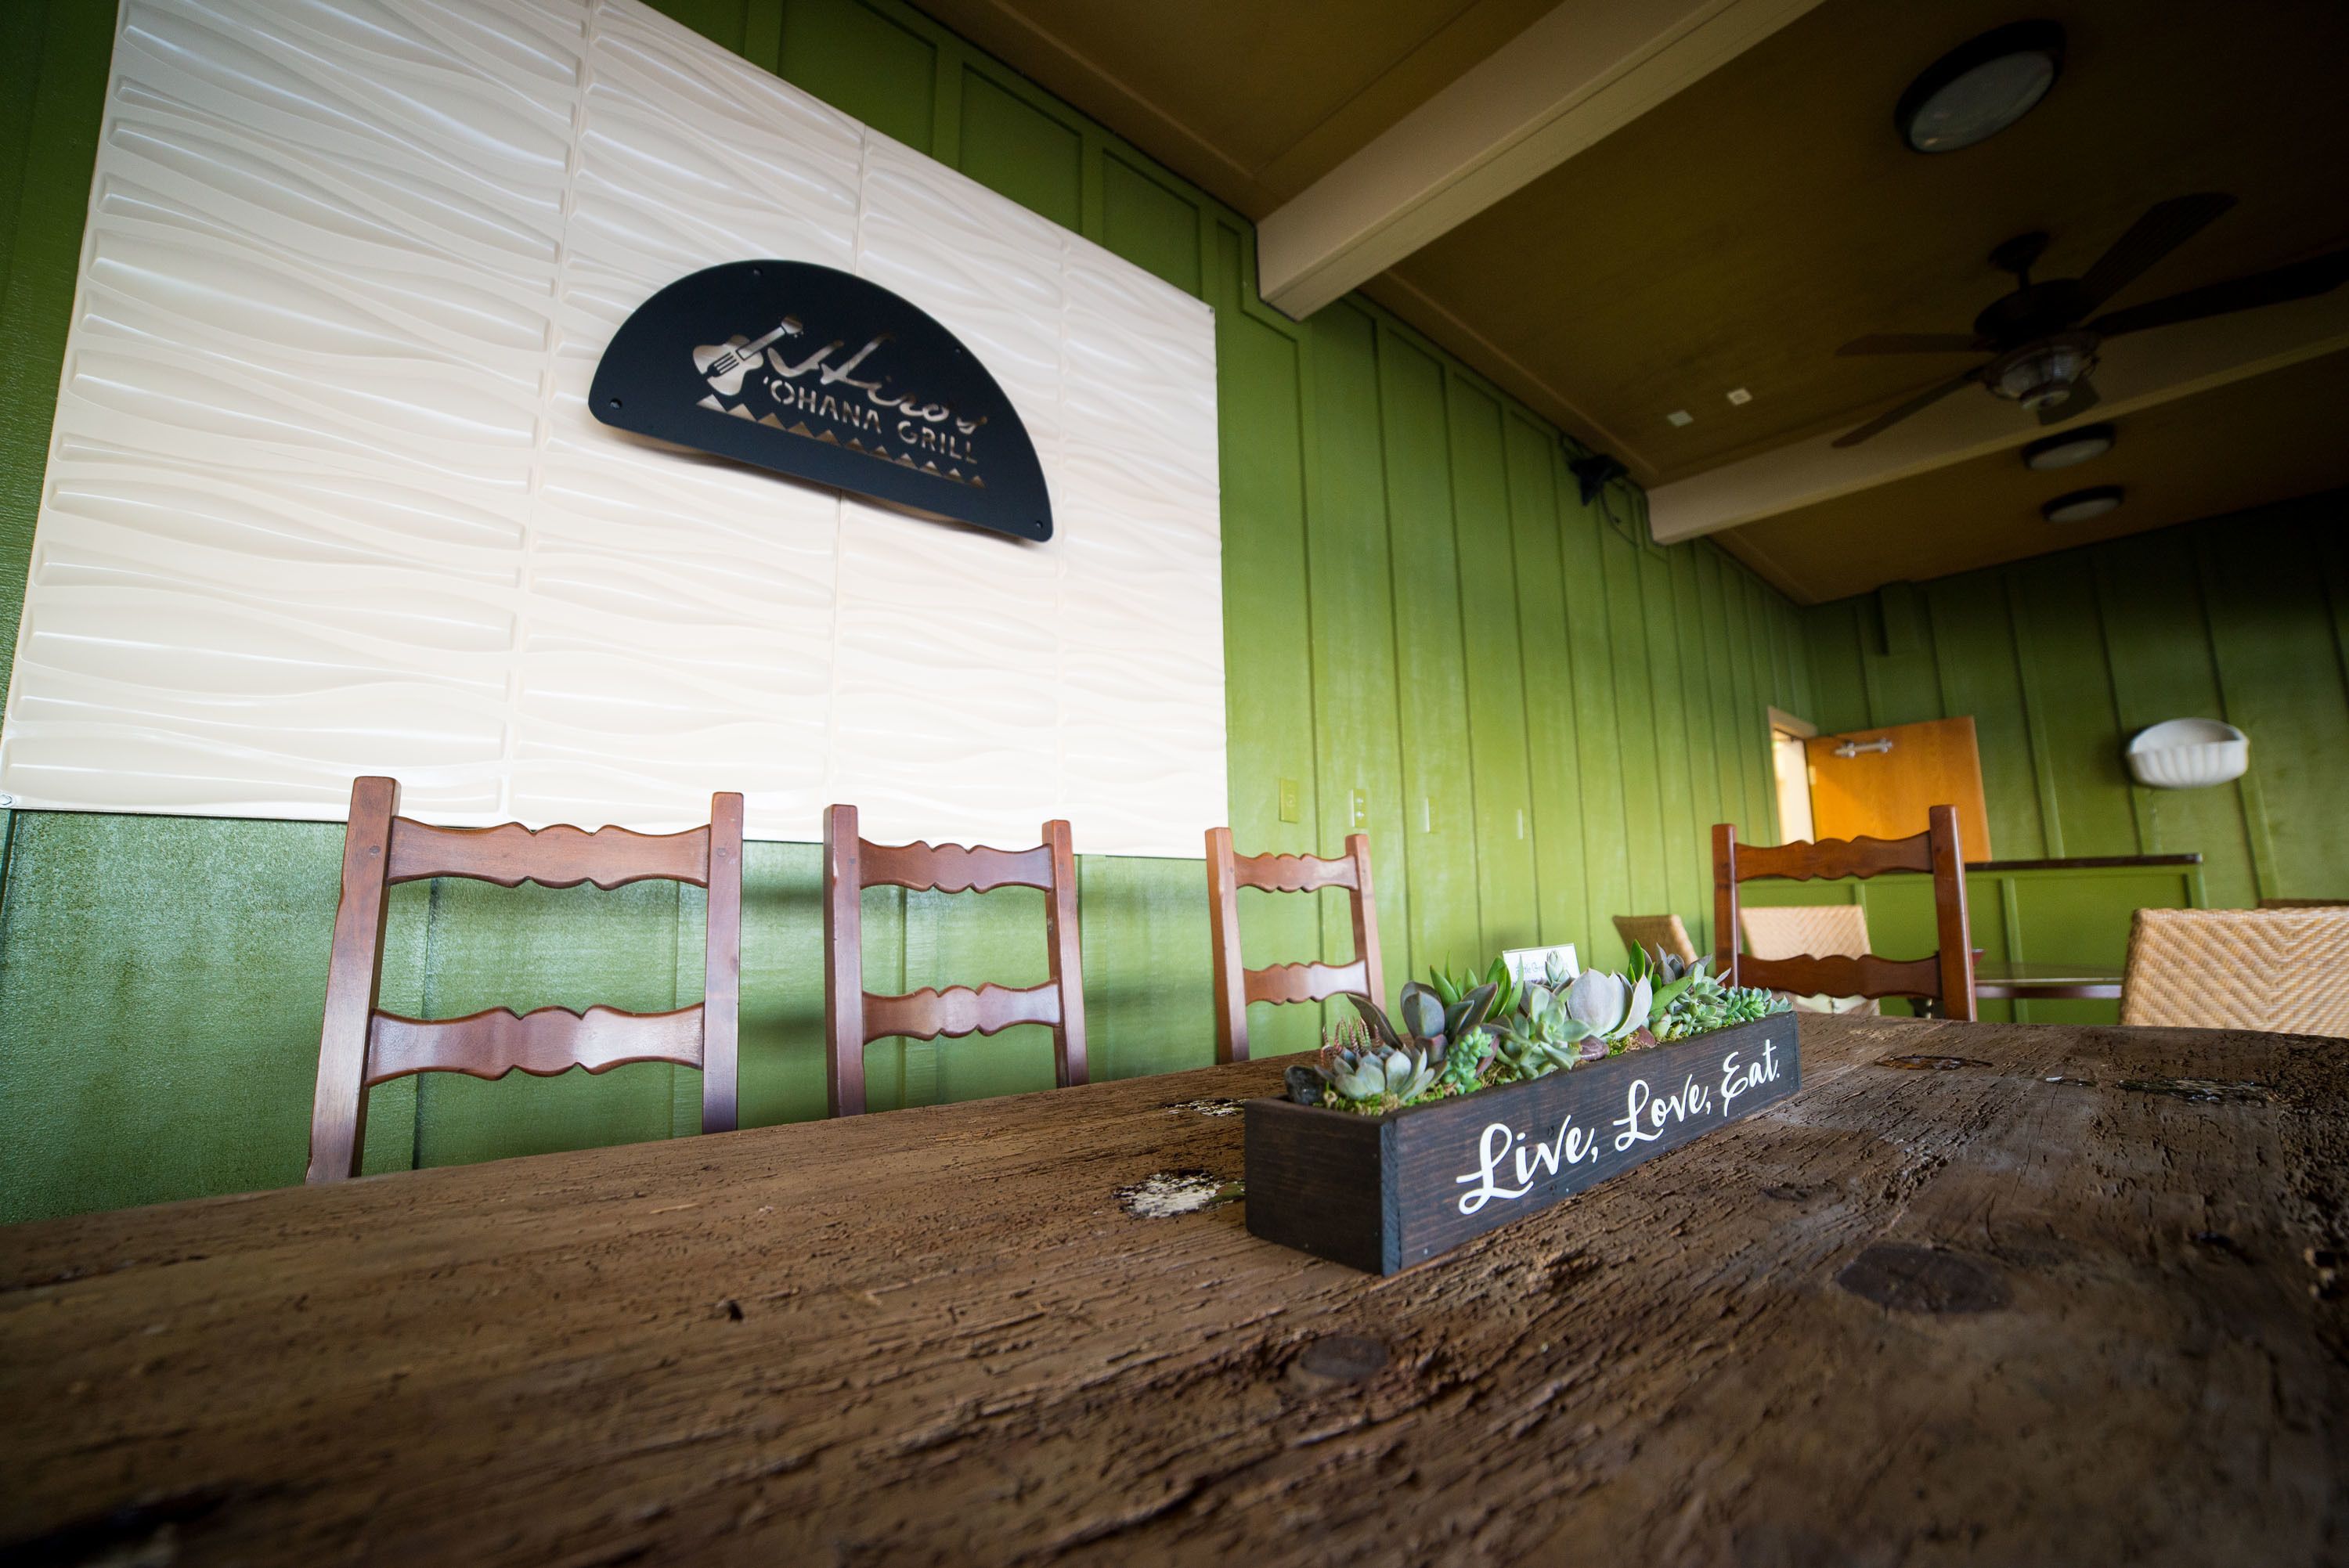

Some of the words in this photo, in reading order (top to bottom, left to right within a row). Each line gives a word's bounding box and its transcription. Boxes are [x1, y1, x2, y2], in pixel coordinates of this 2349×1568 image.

[897, 420, 979, 464] GRILL
[1456, 1114, 1599, 1215] Live,
[1612, 1073, 1712, 1152] Love,
[1720, 1039, 1781, 1117] Eat.
